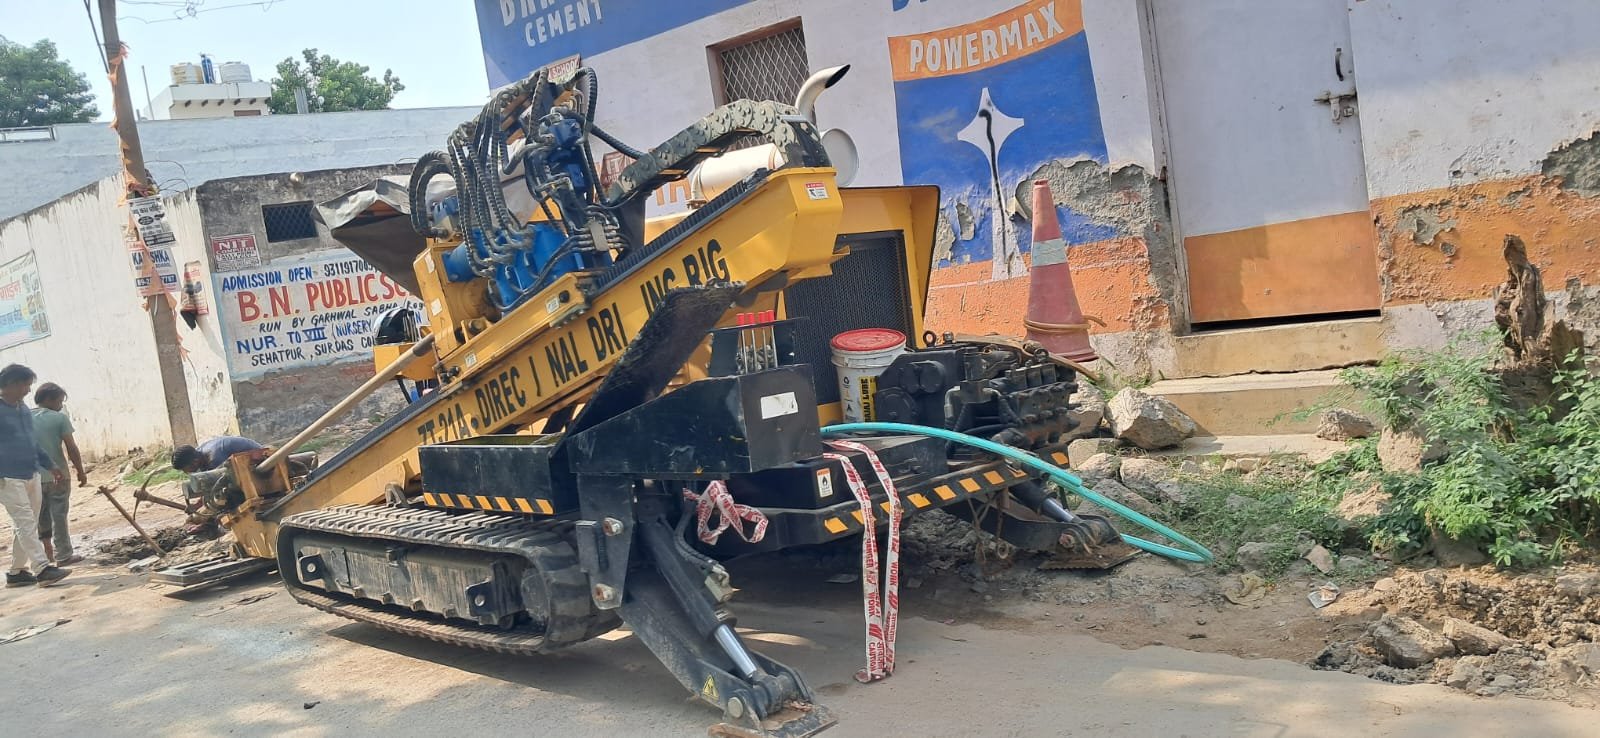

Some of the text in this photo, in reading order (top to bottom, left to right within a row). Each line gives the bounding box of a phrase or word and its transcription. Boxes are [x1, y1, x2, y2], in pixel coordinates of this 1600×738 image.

[525, 1, 602, 47] CEMENT
[909, 3, 1064, 73] POWERMAX
[218, 239, 248, 251] NIT
[222, 270, 283, 292] ADMISSION
[288, 266, 313, 282] OPEN
[238, 285, 300, 322] B.N.
[306, 273, 379, 312] PUBLIC
[259, 321, 281, 333] RUN
[292, 317, 305, 329] BY
[311, 309, 357, 327] GARHWAL
[364, 302, 398, 317] SABHA
[287, 331, 302, 344] TO
[302, 327, 328, 343] VIII
[251, 346, 305, 367] SEHATPUR
[889, 561, 899, 586] WORK
[867, 591, 876, 617] WORK
[868, 641, 877, 672] CAUTION
